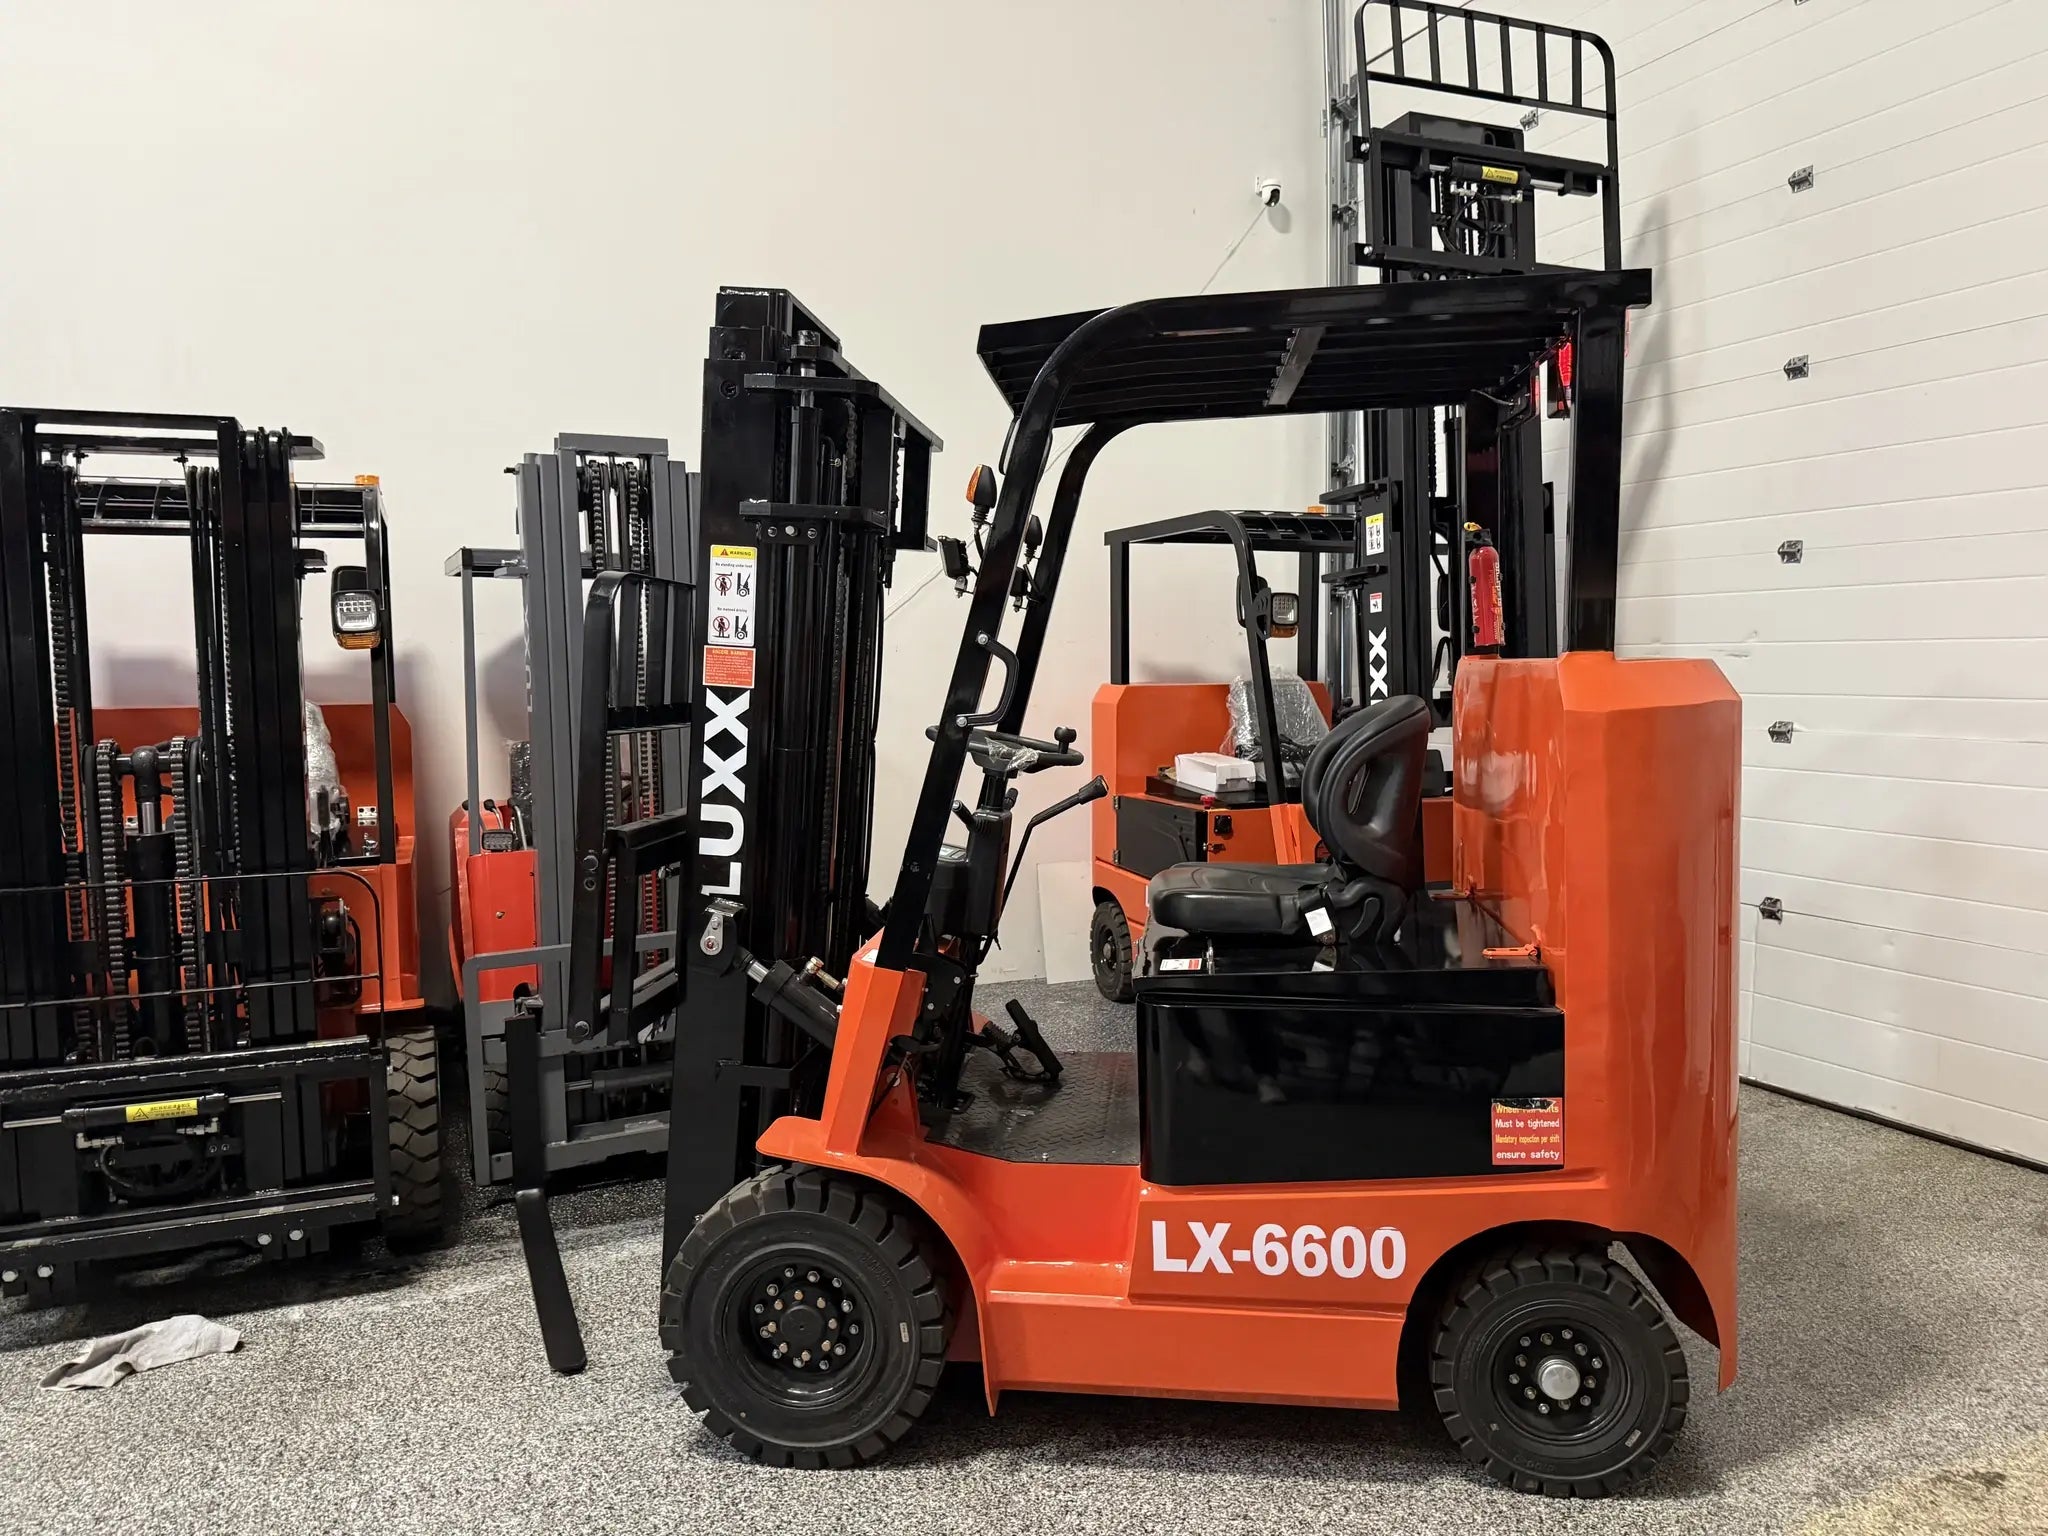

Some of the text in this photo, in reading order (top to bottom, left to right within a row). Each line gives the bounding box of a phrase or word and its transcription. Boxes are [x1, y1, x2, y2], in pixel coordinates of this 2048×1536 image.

[1368, 626, 1388, 706] XX
[698, 688, 751, 897] LUXX
[1495, 1118, 1560, 1129] Must be tightened
[1540, 1136, 1548, 1144] per
[1496, 1149, 1560, 1160] ensure safety
[1151, 1220, 1407, 1279] LX-6600
